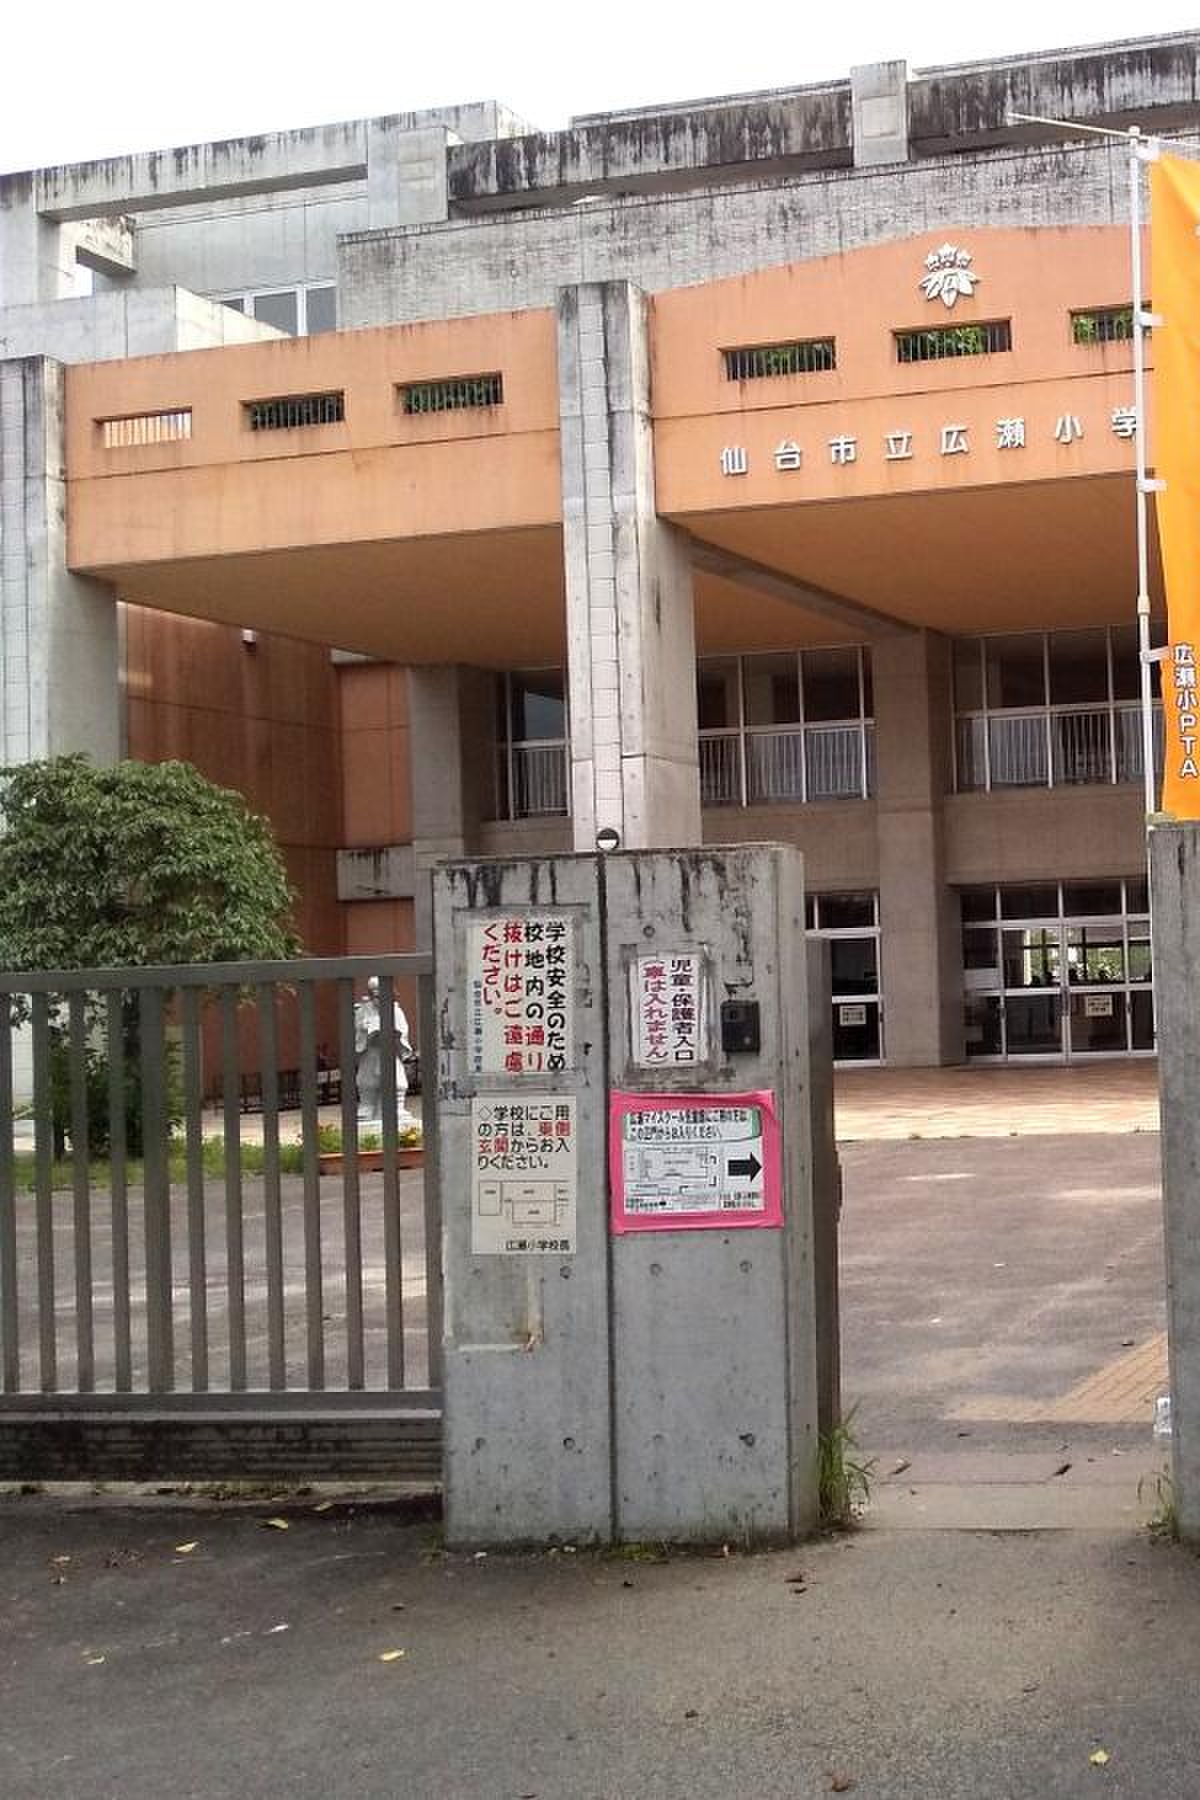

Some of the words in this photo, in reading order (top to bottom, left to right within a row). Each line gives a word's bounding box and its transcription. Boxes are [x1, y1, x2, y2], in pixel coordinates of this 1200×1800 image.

[1174, 642, 1198, 778] 広瀬小PTA
[481, 924, 502, 1015] ください。
[503, 922, 523, 1073] 抜けはご遠慮
[524, 922, 545, 1071] 校地内の通り
[545, 921, 566, 1071] 学校安全のため
[478, 1155, 549, 1170] りください。
[479, 1137, 570, 1153] 玄関からお入
